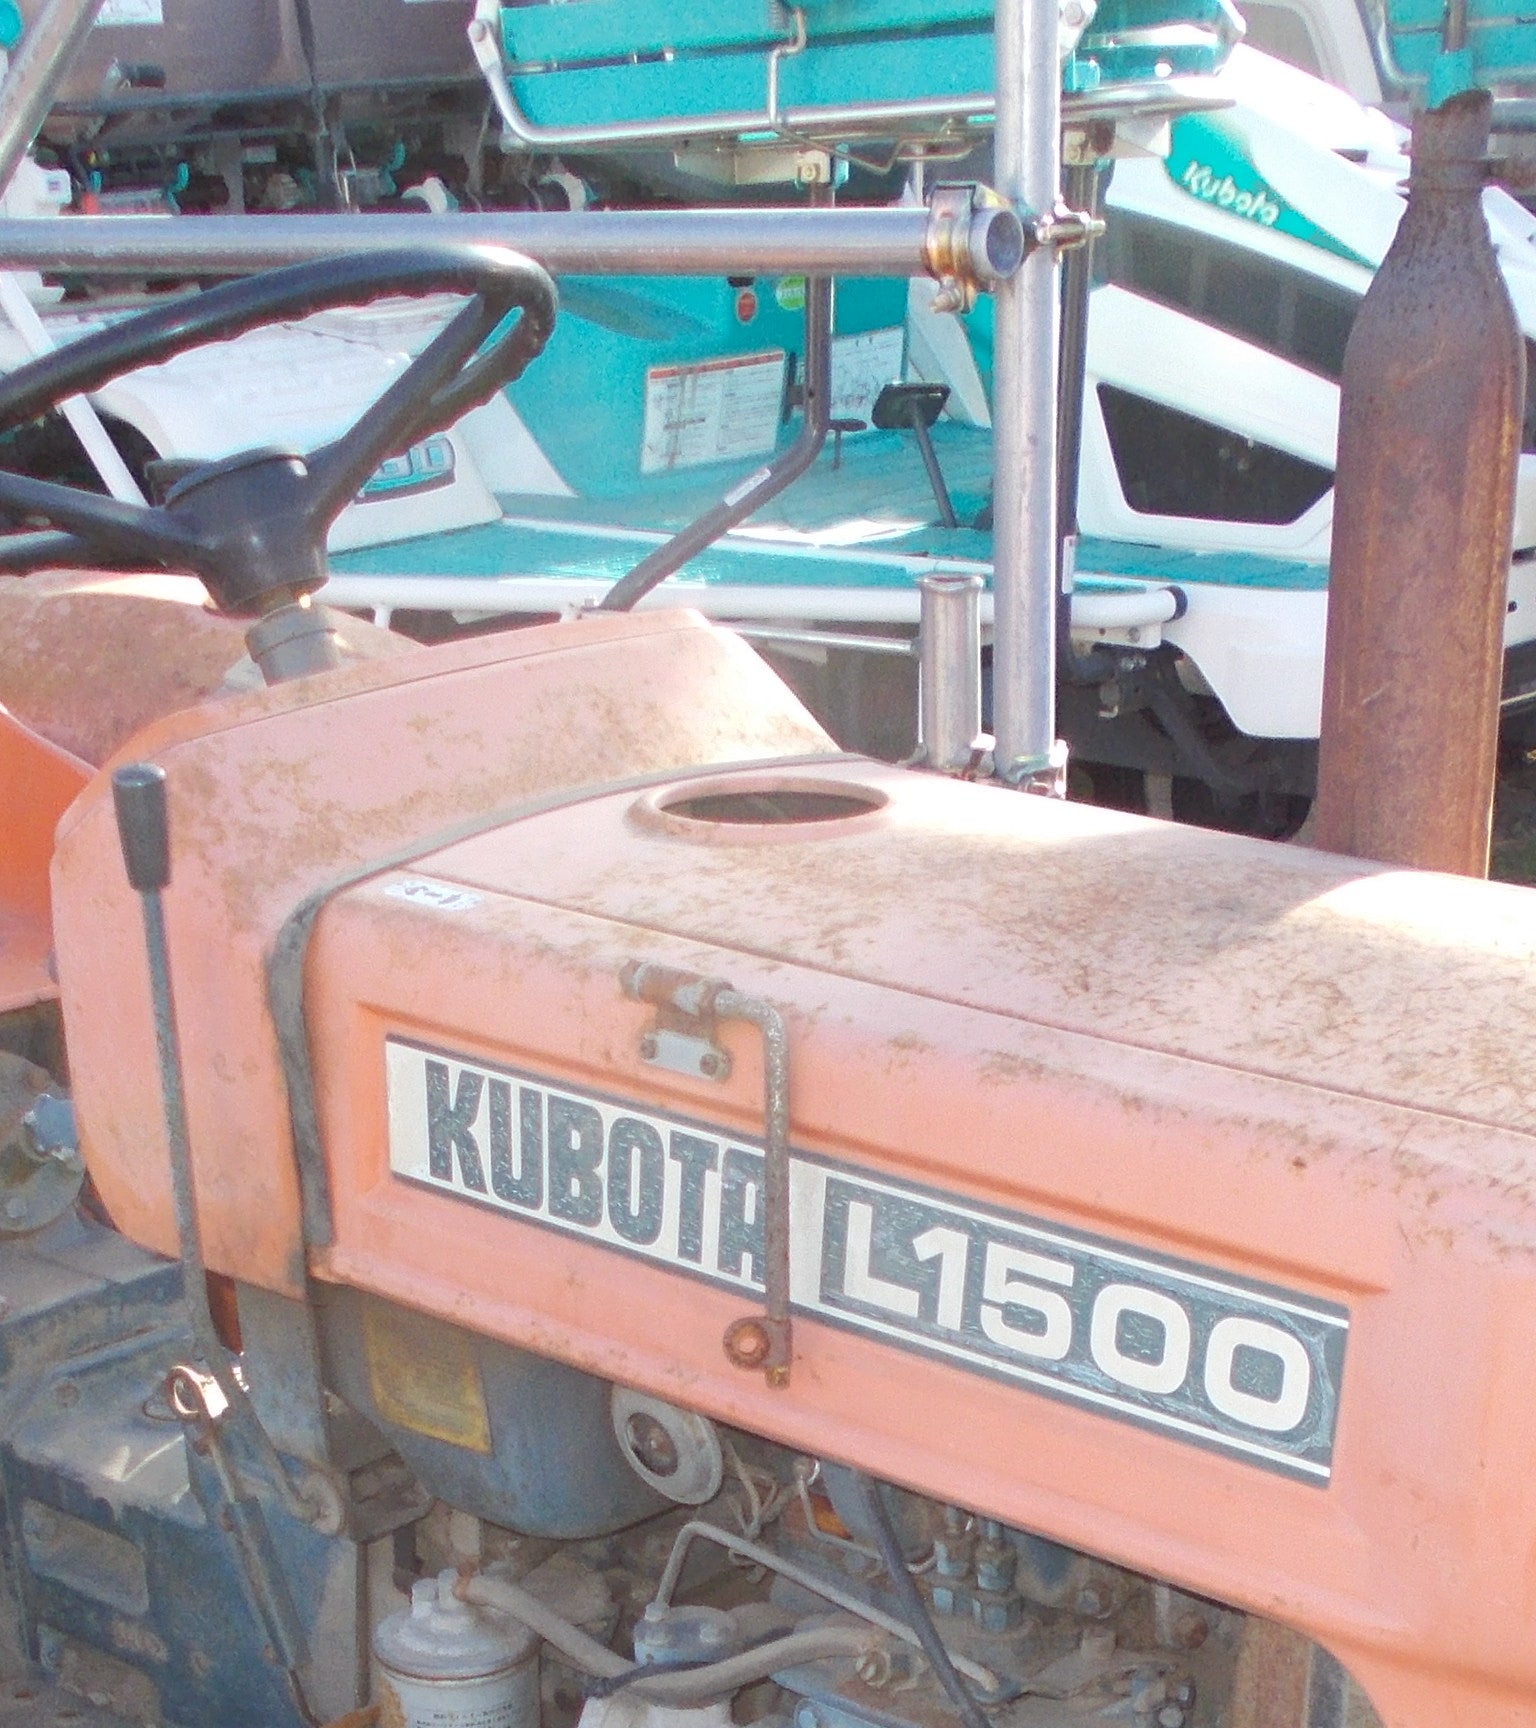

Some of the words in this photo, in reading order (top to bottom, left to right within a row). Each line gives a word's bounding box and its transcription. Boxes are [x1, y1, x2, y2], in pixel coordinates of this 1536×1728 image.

[1183, 160, 1279, 226] Kubota
[424, 1058, 768, 1285] KUBOTA
[843, 1200, 1311, 1432] L1500
